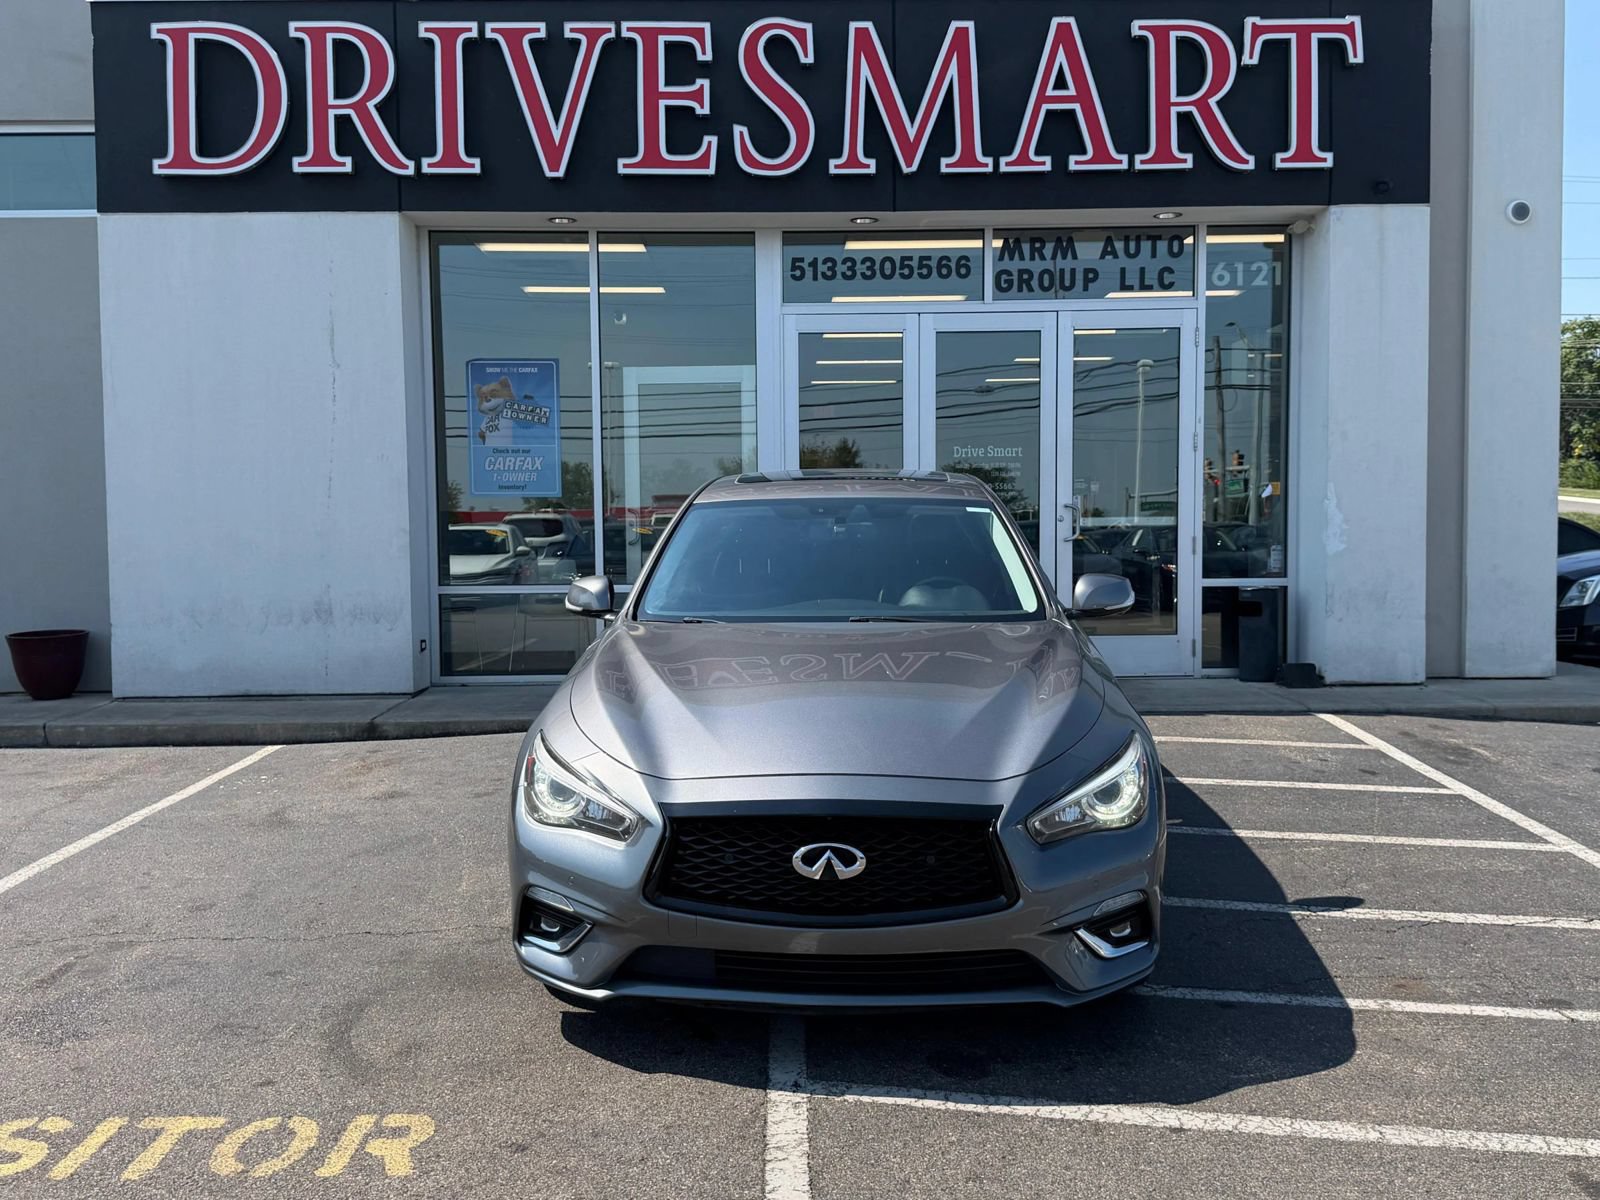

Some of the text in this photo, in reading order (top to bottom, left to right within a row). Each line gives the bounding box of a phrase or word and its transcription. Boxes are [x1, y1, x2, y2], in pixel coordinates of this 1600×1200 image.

[150, 16, 1364, 178] DRIVESMART
[998, 233, 1185, 262] MRM AUTO
[789, 254, 972, 282] 5133305566
[994, 266, 1176, 294] GROUP LLC
[1210, 260, 1282, 287] 6121
[505, 401, 550, 417] CARFAX
[485, 456, 544, 470] CARFAX
[953, 445, 1023, 457] Drive Smart
